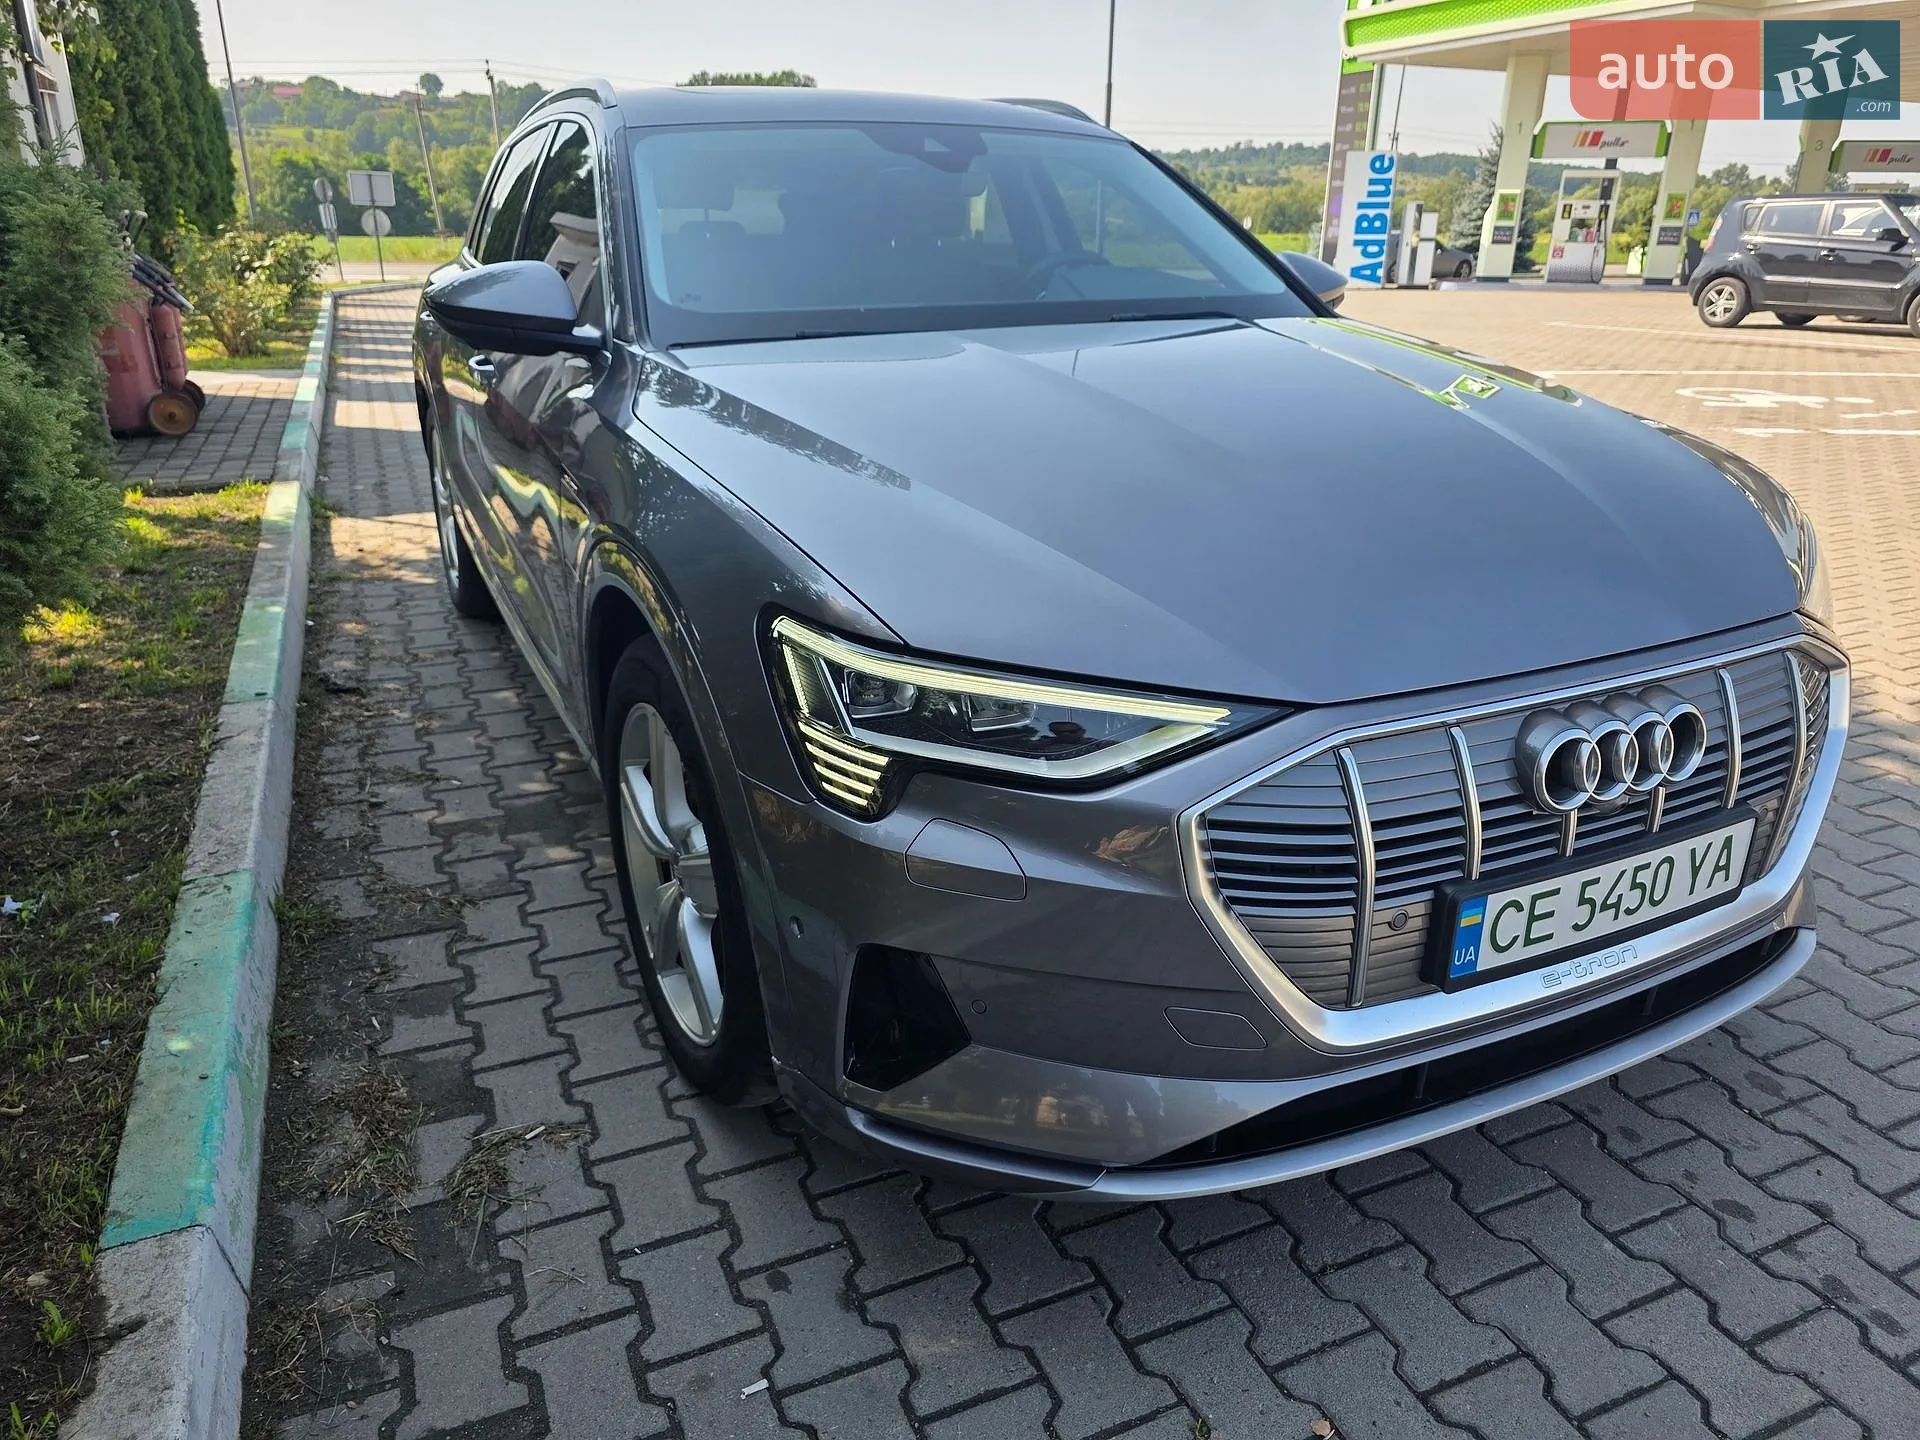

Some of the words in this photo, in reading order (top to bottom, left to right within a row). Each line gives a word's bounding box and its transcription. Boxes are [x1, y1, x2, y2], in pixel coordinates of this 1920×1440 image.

[1815, 139, 1824, 151] 3
[1349, 153, 1395, 284] AdBlue
[1489, 886, 1561, 954] CE
[1571, 855, 1675, 932] 5450
[1688, 834, 1734, 898] YA
[1453, 948, 1476, 966] UA
[1540, 944, 1639, 989] e-tron
